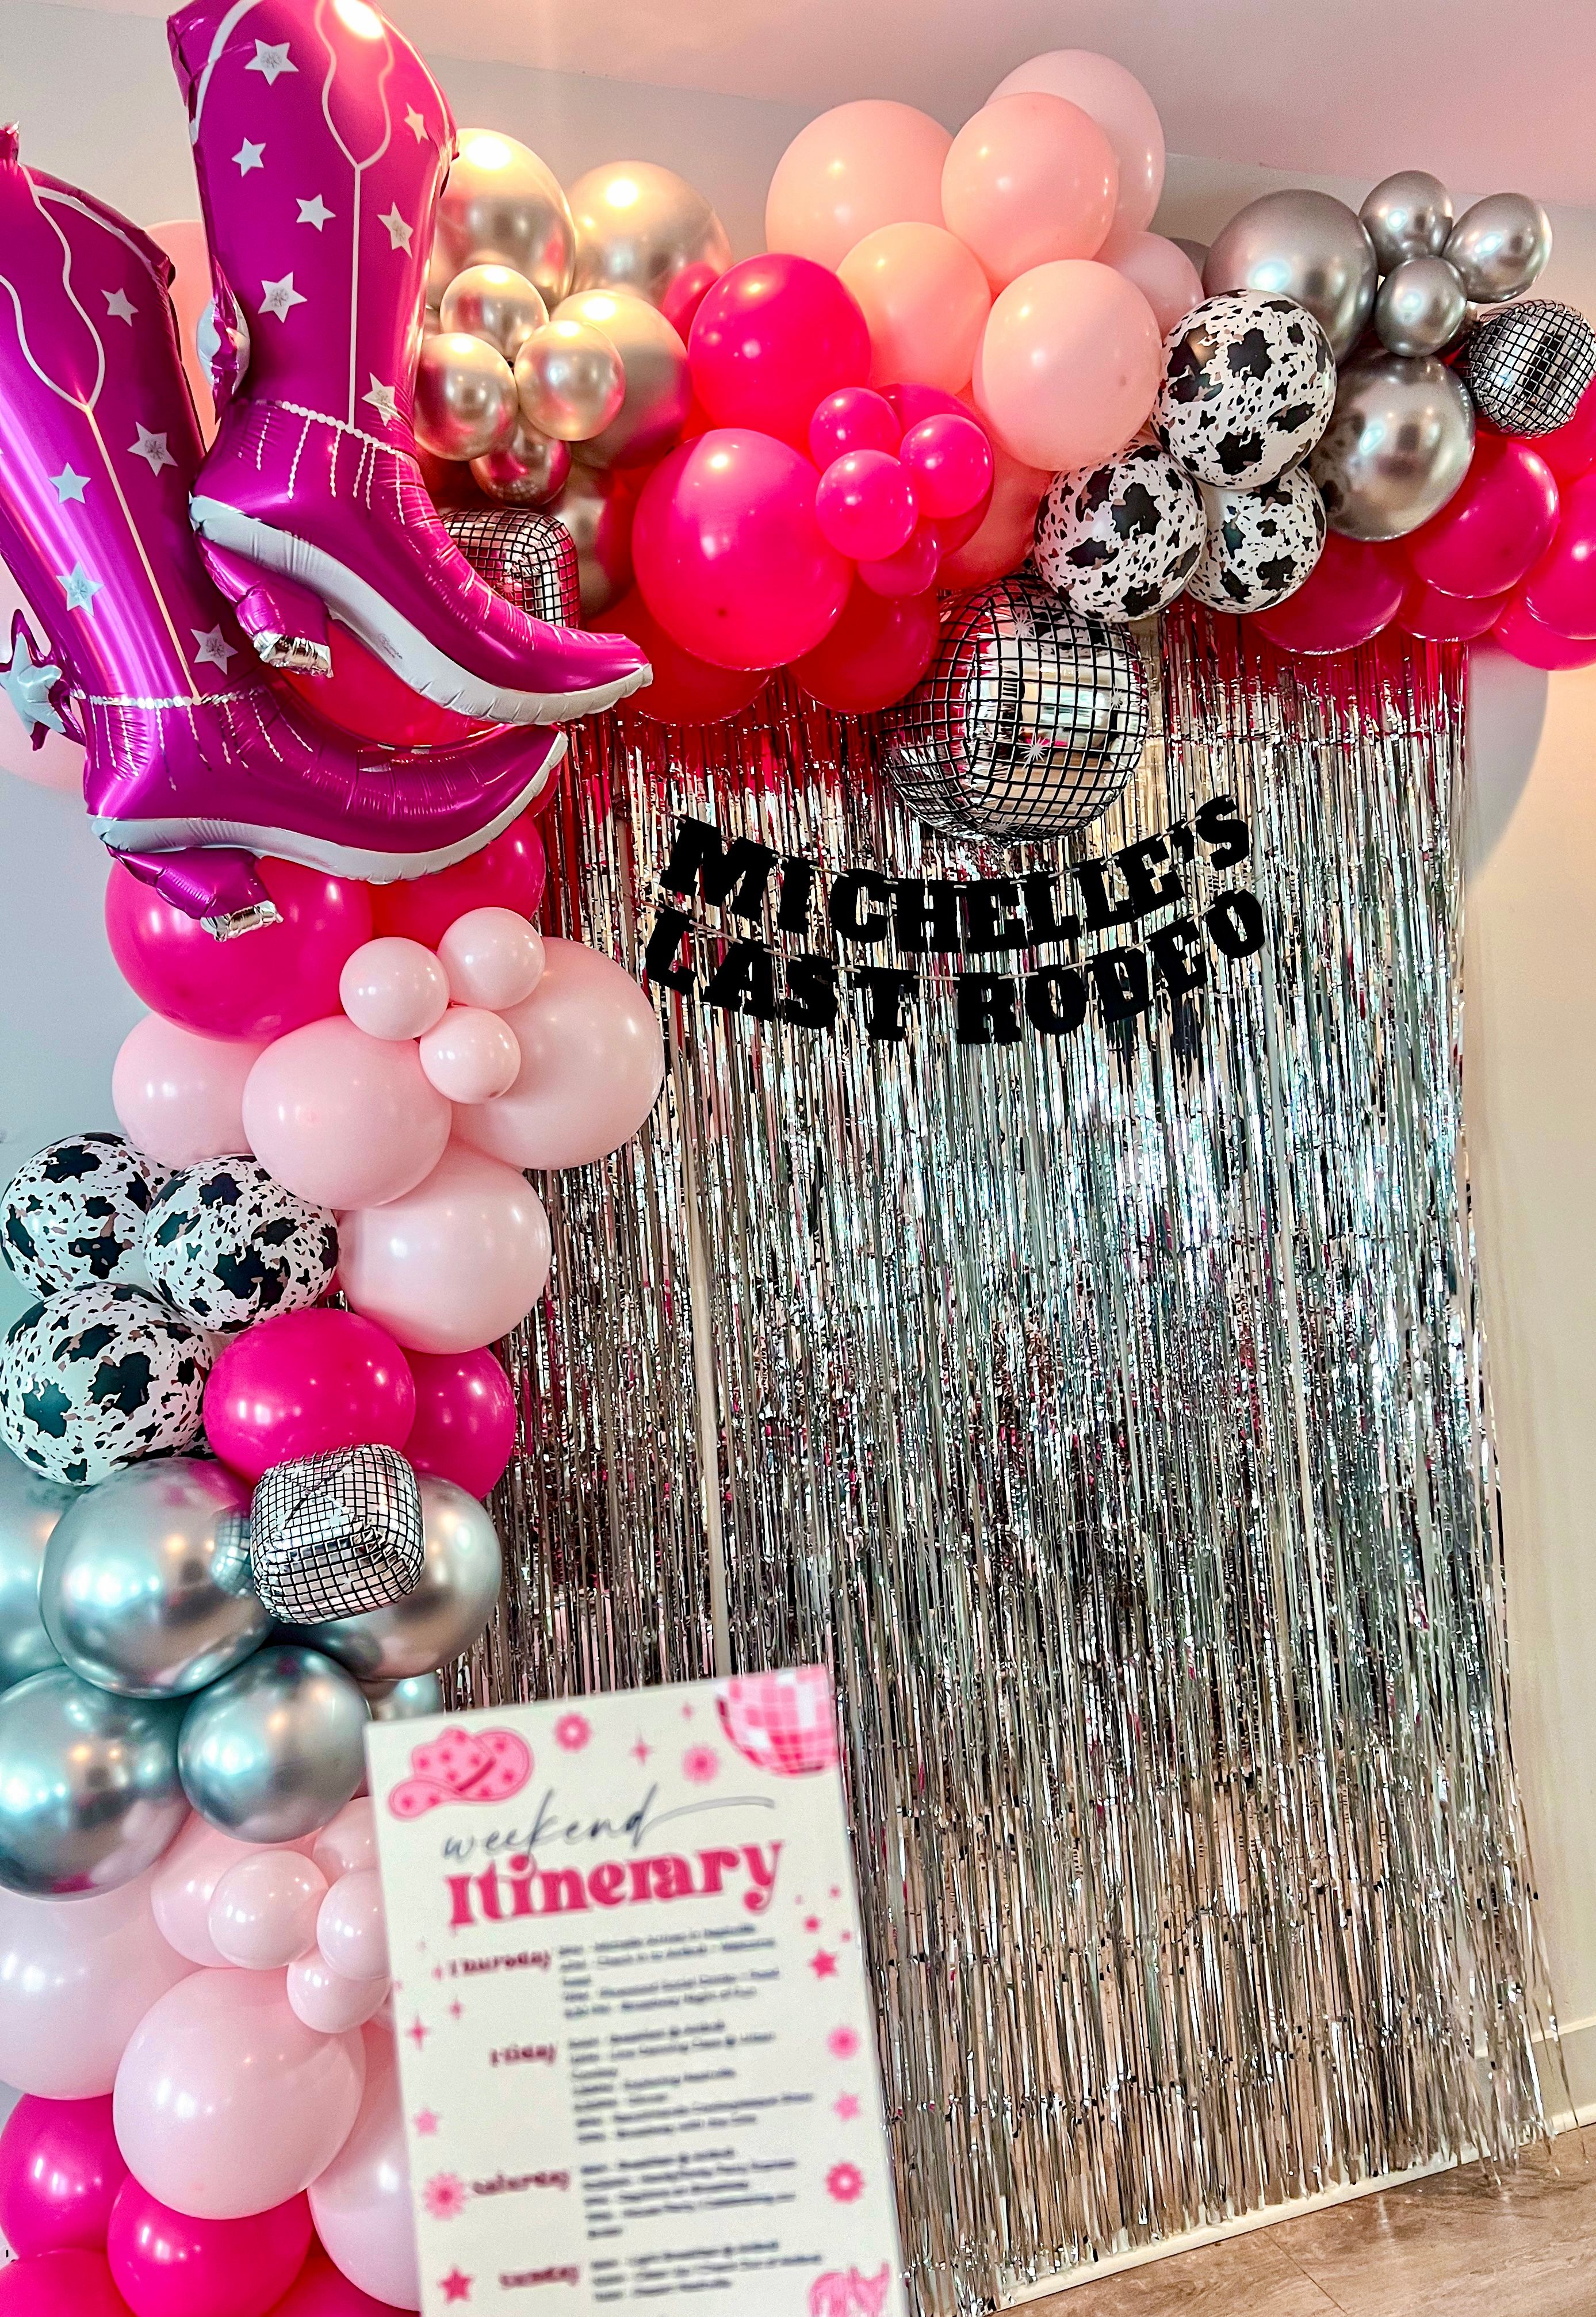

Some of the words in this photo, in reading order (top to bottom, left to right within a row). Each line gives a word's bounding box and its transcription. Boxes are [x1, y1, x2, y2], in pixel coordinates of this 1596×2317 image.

[659, 794, 1252, 953] MICHELLE'S
[646, 903, 922, 1042] LAST
[956, 888, 1267, 1044] RODEO
[442, 1782, 775, 1862] weekend
[445, 1840, 784, 1930] Itinerary
